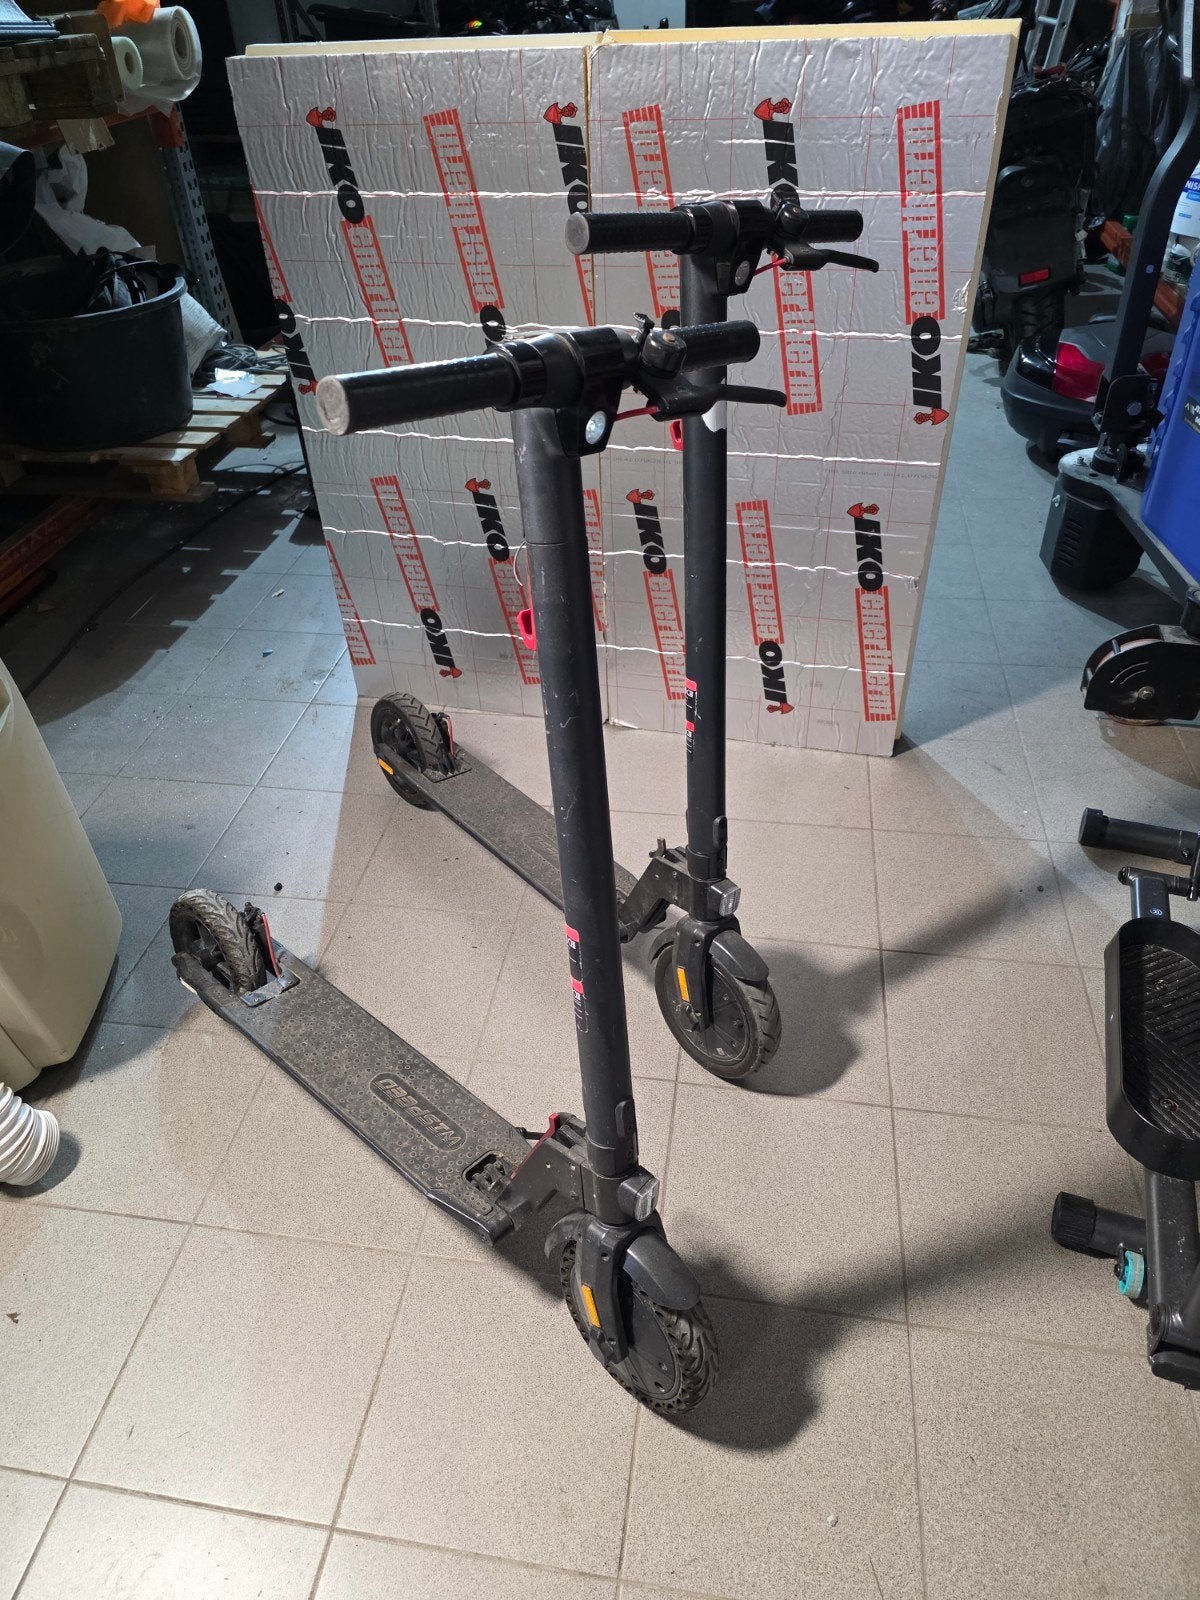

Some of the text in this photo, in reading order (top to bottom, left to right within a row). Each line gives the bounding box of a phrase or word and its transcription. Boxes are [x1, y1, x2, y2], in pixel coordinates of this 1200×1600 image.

[315, 126, 365, 223] IKO
[911, 316, 943, 408] IKO
[473, 493, 510, 561] IKO
[633, 503, 667, 574] IKO
[854, 518, 884, 591] IKO
[421, 608, 455, 669] IKO
[760, 641, 788, 702] IKO
